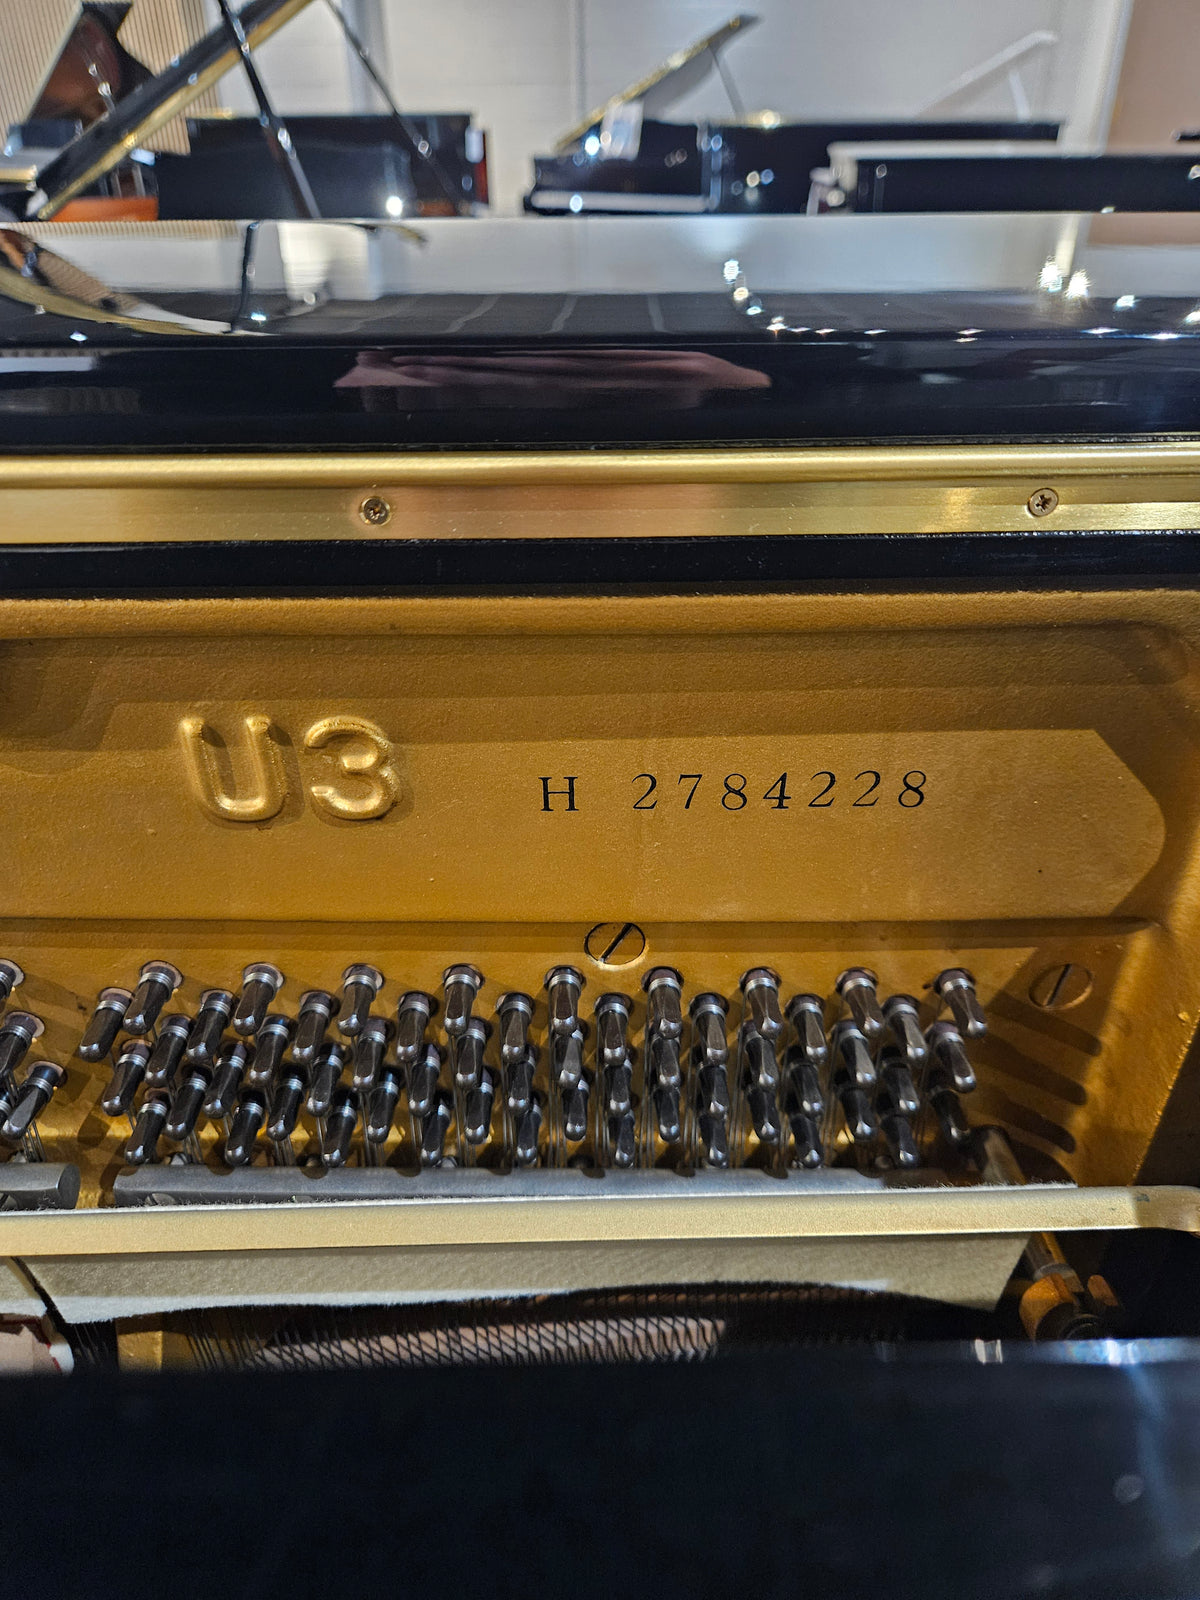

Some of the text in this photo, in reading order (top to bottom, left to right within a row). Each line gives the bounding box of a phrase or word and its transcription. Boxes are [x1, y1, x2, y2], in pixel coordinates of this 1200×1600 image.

[178, 714, 399, 822] U3
[538, 770, 927, 811] H 2784228
